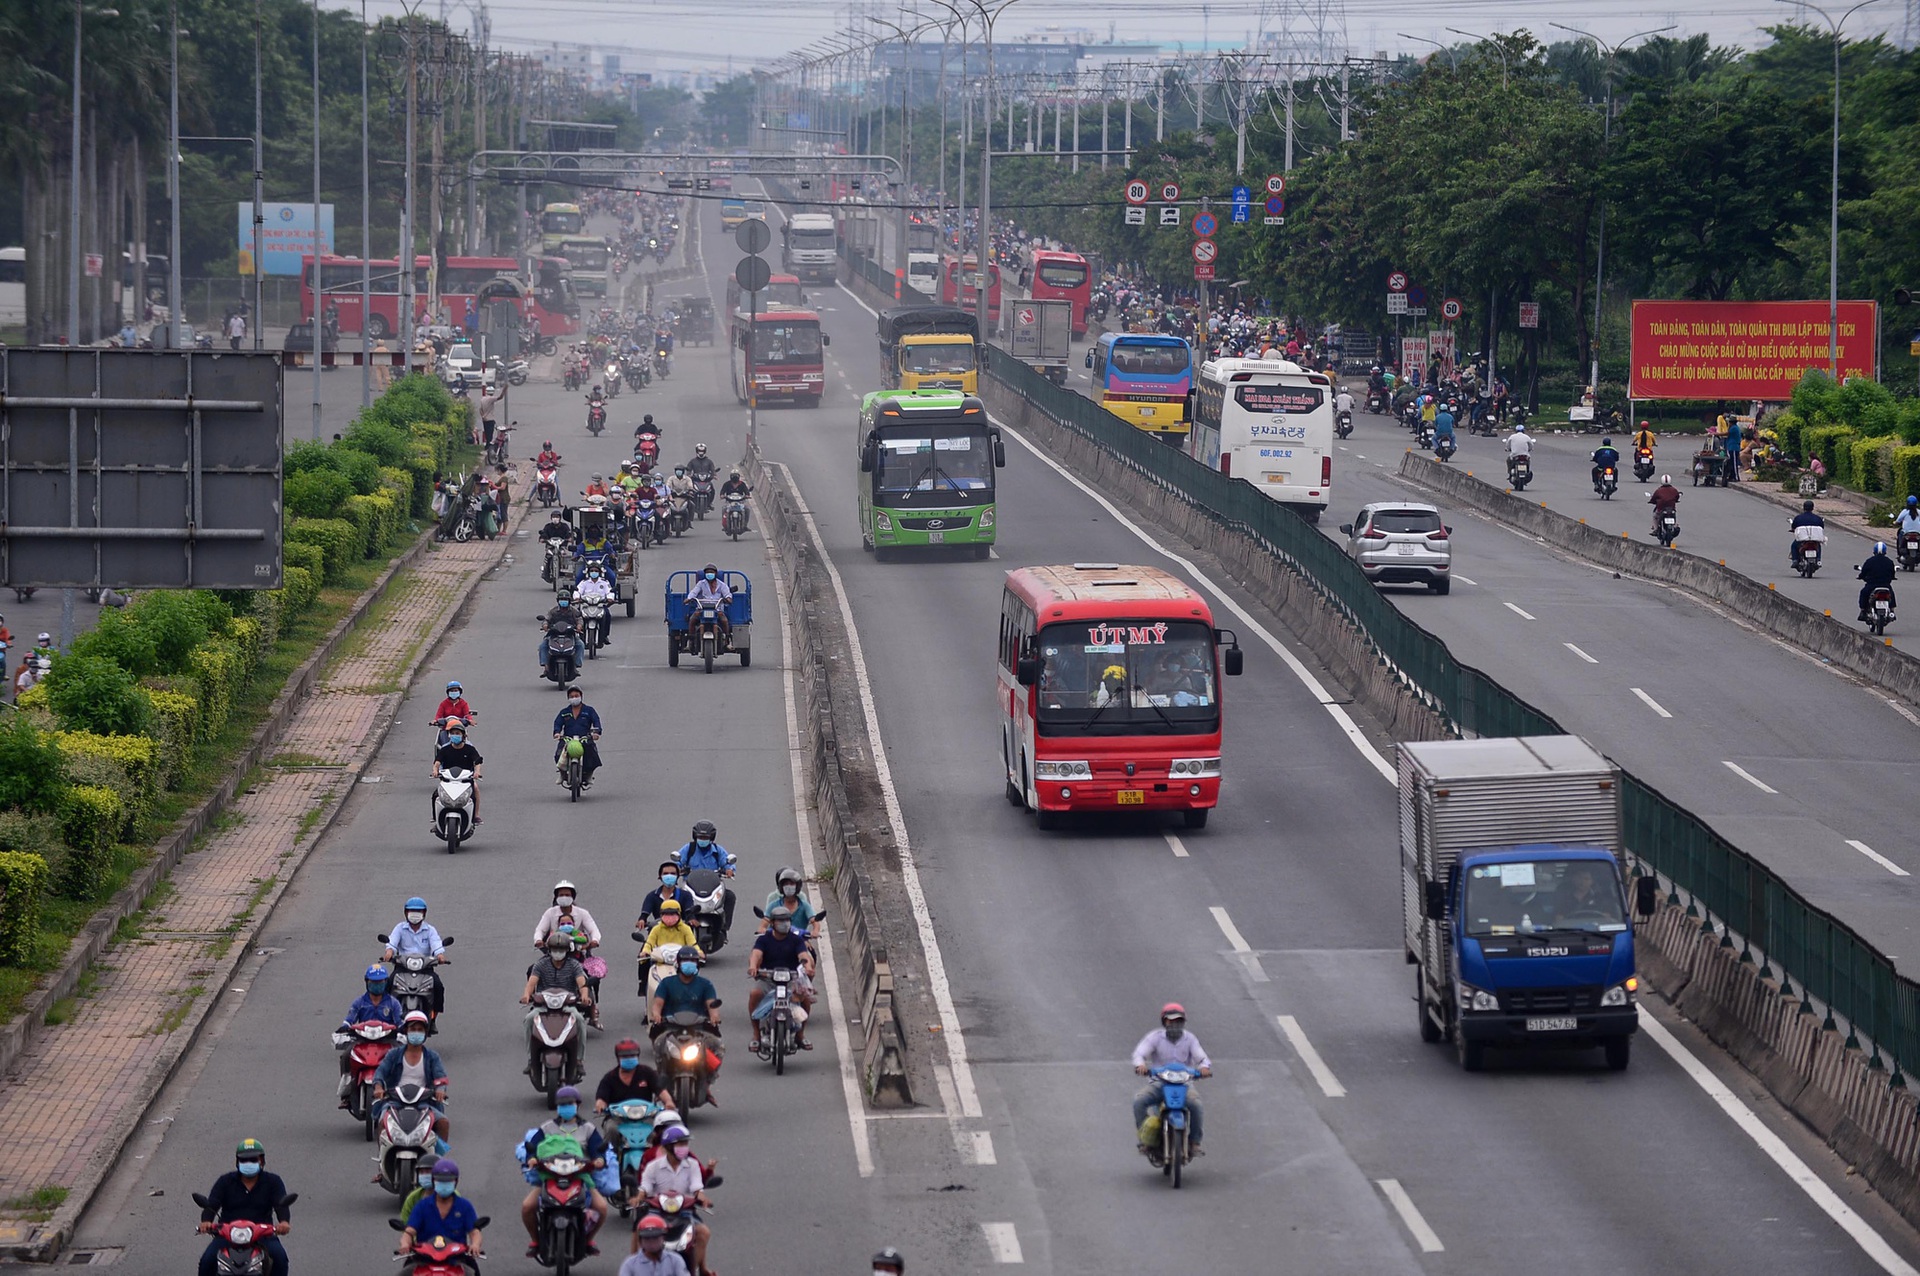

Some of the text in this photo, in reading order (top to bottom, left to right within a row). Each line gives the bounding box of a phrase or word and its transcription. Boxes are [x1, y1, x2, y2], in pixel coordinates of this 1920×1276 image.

[1270, 180, 1280, 190] 50
[1130, 186, 1143, 198] 80
[1166, 188, 1176, 197] 60
[1446, 304, 1458, 314] 50
[1650, 320, 1668, 336] TOÀN
[1692, 320, 1710, 336] TOÀN
[1729, 320, 1747, 336] TOÀN
[1748, 320, 1768, 338] QUÂN
[1770, 324, 1780, 336] THI
[1782, 324, 1796, 336] ĐUA
[1798, 320, 1812, 338] LẬP
[1814, 321, 1832, 336] THÀN
[1839, 321, 1856, 336] TÍCH
[1660, 342, 1678, 358] CHÀO
[1680, 342, 1699, 358] MỪNG
[1701, 342, 1719, 360] CUỘC
[1736, 340, 1747, 358] CỬ
[1748, 345, 1760, 360] ĐẠI
[1762, 339, 1778, 358] BIỂU
[1780, 341, 1798, 360] QUỐC
[1800, 342, 1812, 360] HỘI
[1814, 343, 1831, 358] KHÓ
[1641, 363, 1650, 378] VÀ
[1652, 366, 1664, 381] ĐẠI
[1666, 361, 1681, 379] BIỂU
[1684, 363, 1695, 382] HỘI
[1717, 364, 1736, 379] NHÂN
[1738, 364, 1752, 380] DÂN
[1754, 364, 1768, 380] CÁC
[1769, 363, 1783, 380] CẤP
[1088, 622, 1168, 646] ÚT MỸ
[1527, 947, 1569, 956] ISUZU
